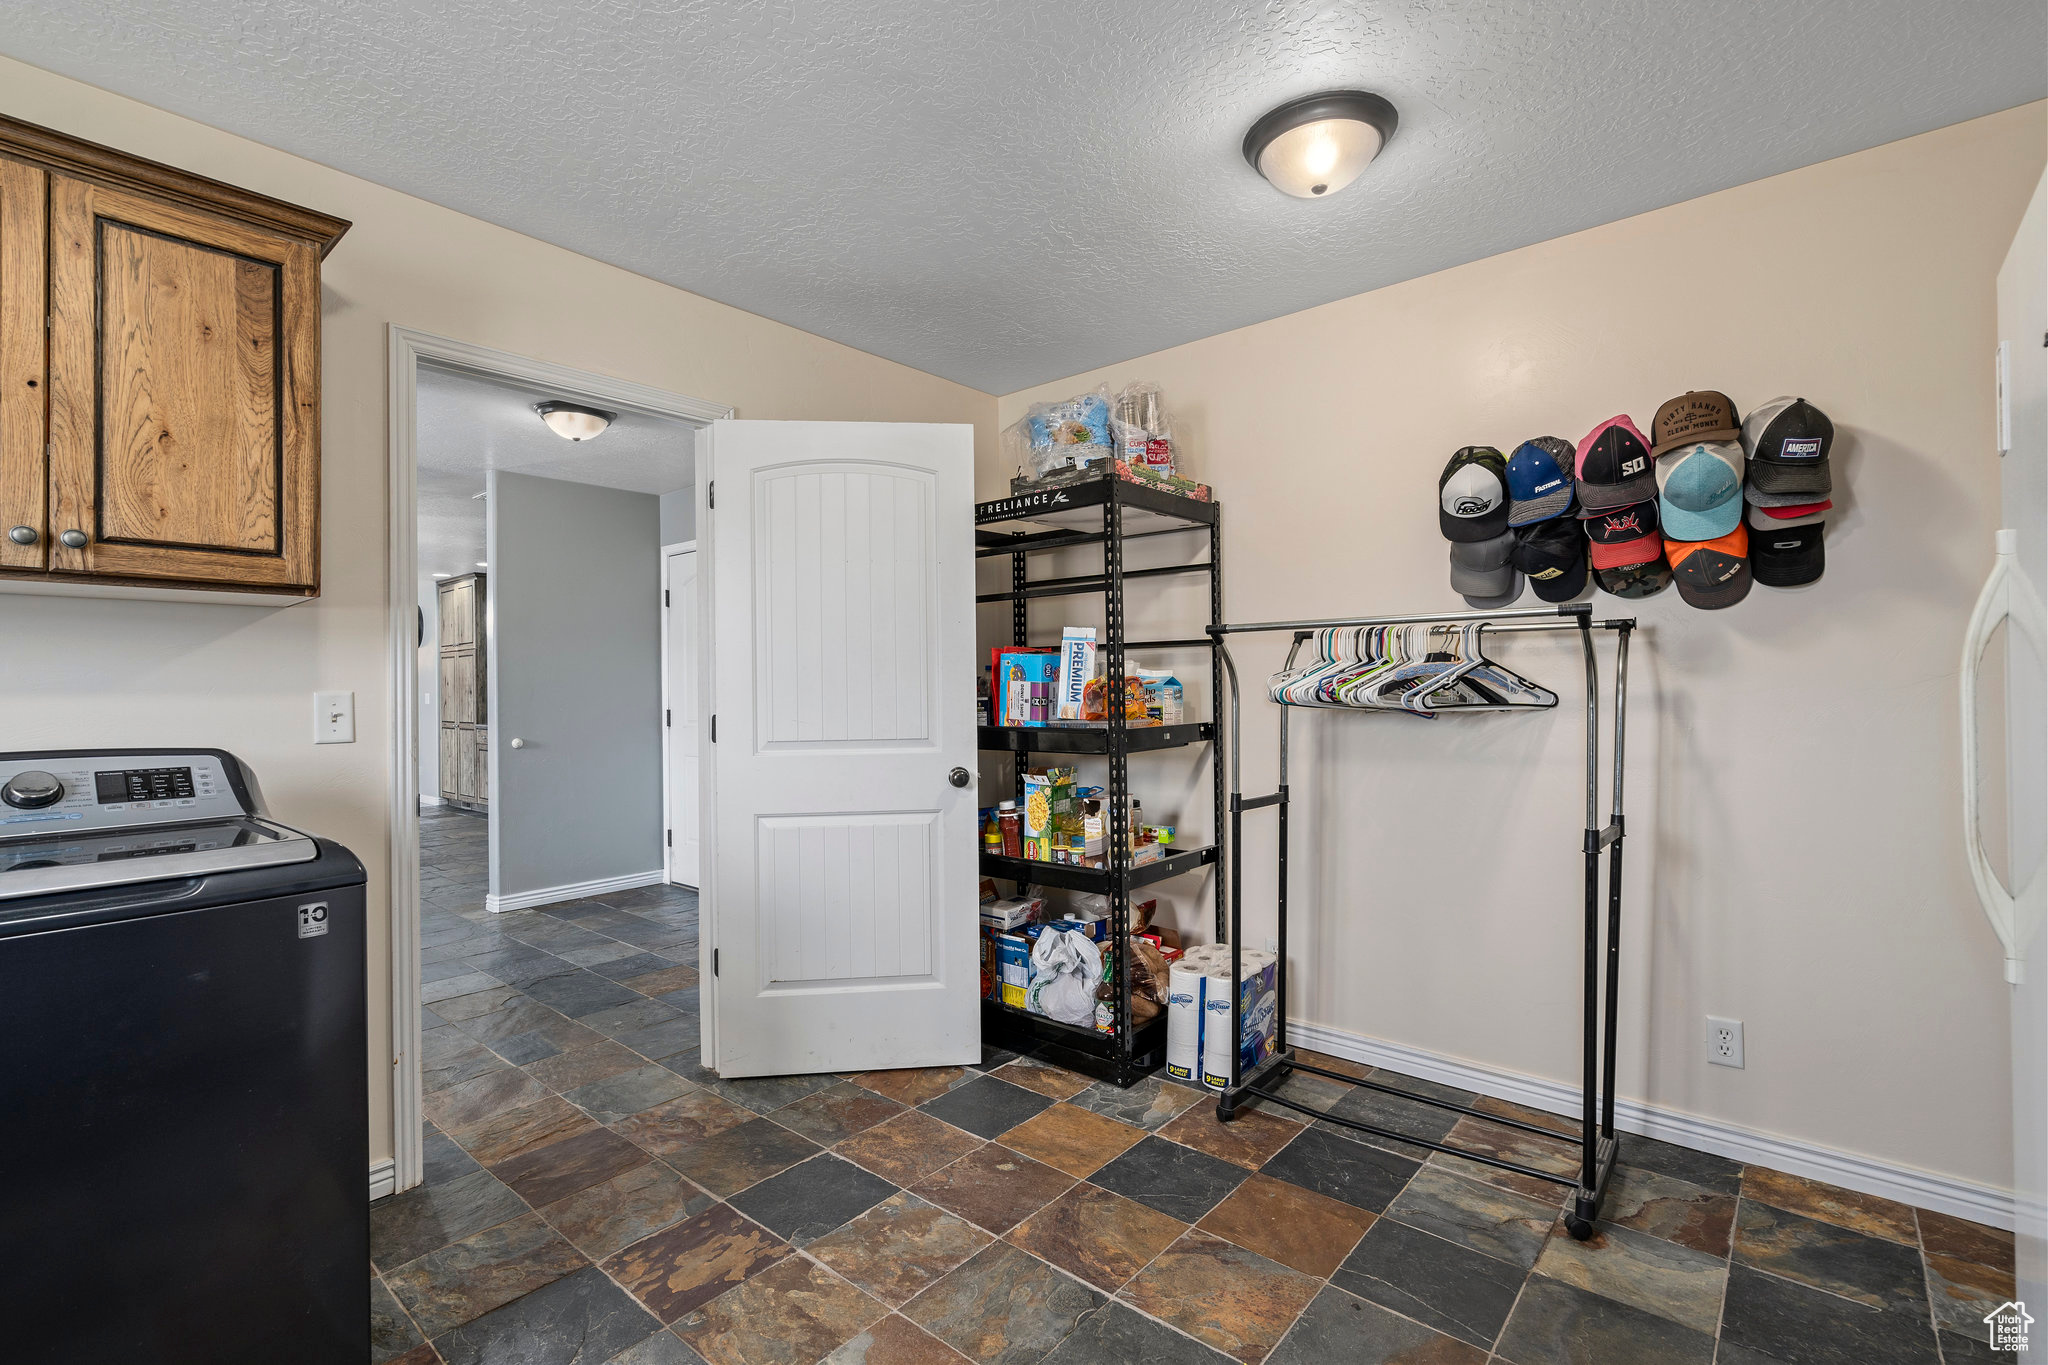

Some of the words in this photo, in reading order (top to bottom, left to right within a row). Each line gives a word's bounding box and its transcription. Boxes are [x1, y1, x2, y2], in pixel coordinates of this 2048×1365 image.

[1663, 405, 1685, 426] DIRTY
[1667, 425, 1690, 436] CLEAN
[1693, 420, 1719, 429] MONEY
[1786, 443, 1817, 453] AMERICA
[1148, 454, 1168, 462] CUPS
[1070, 642, 1085, 703] PREMIUM
